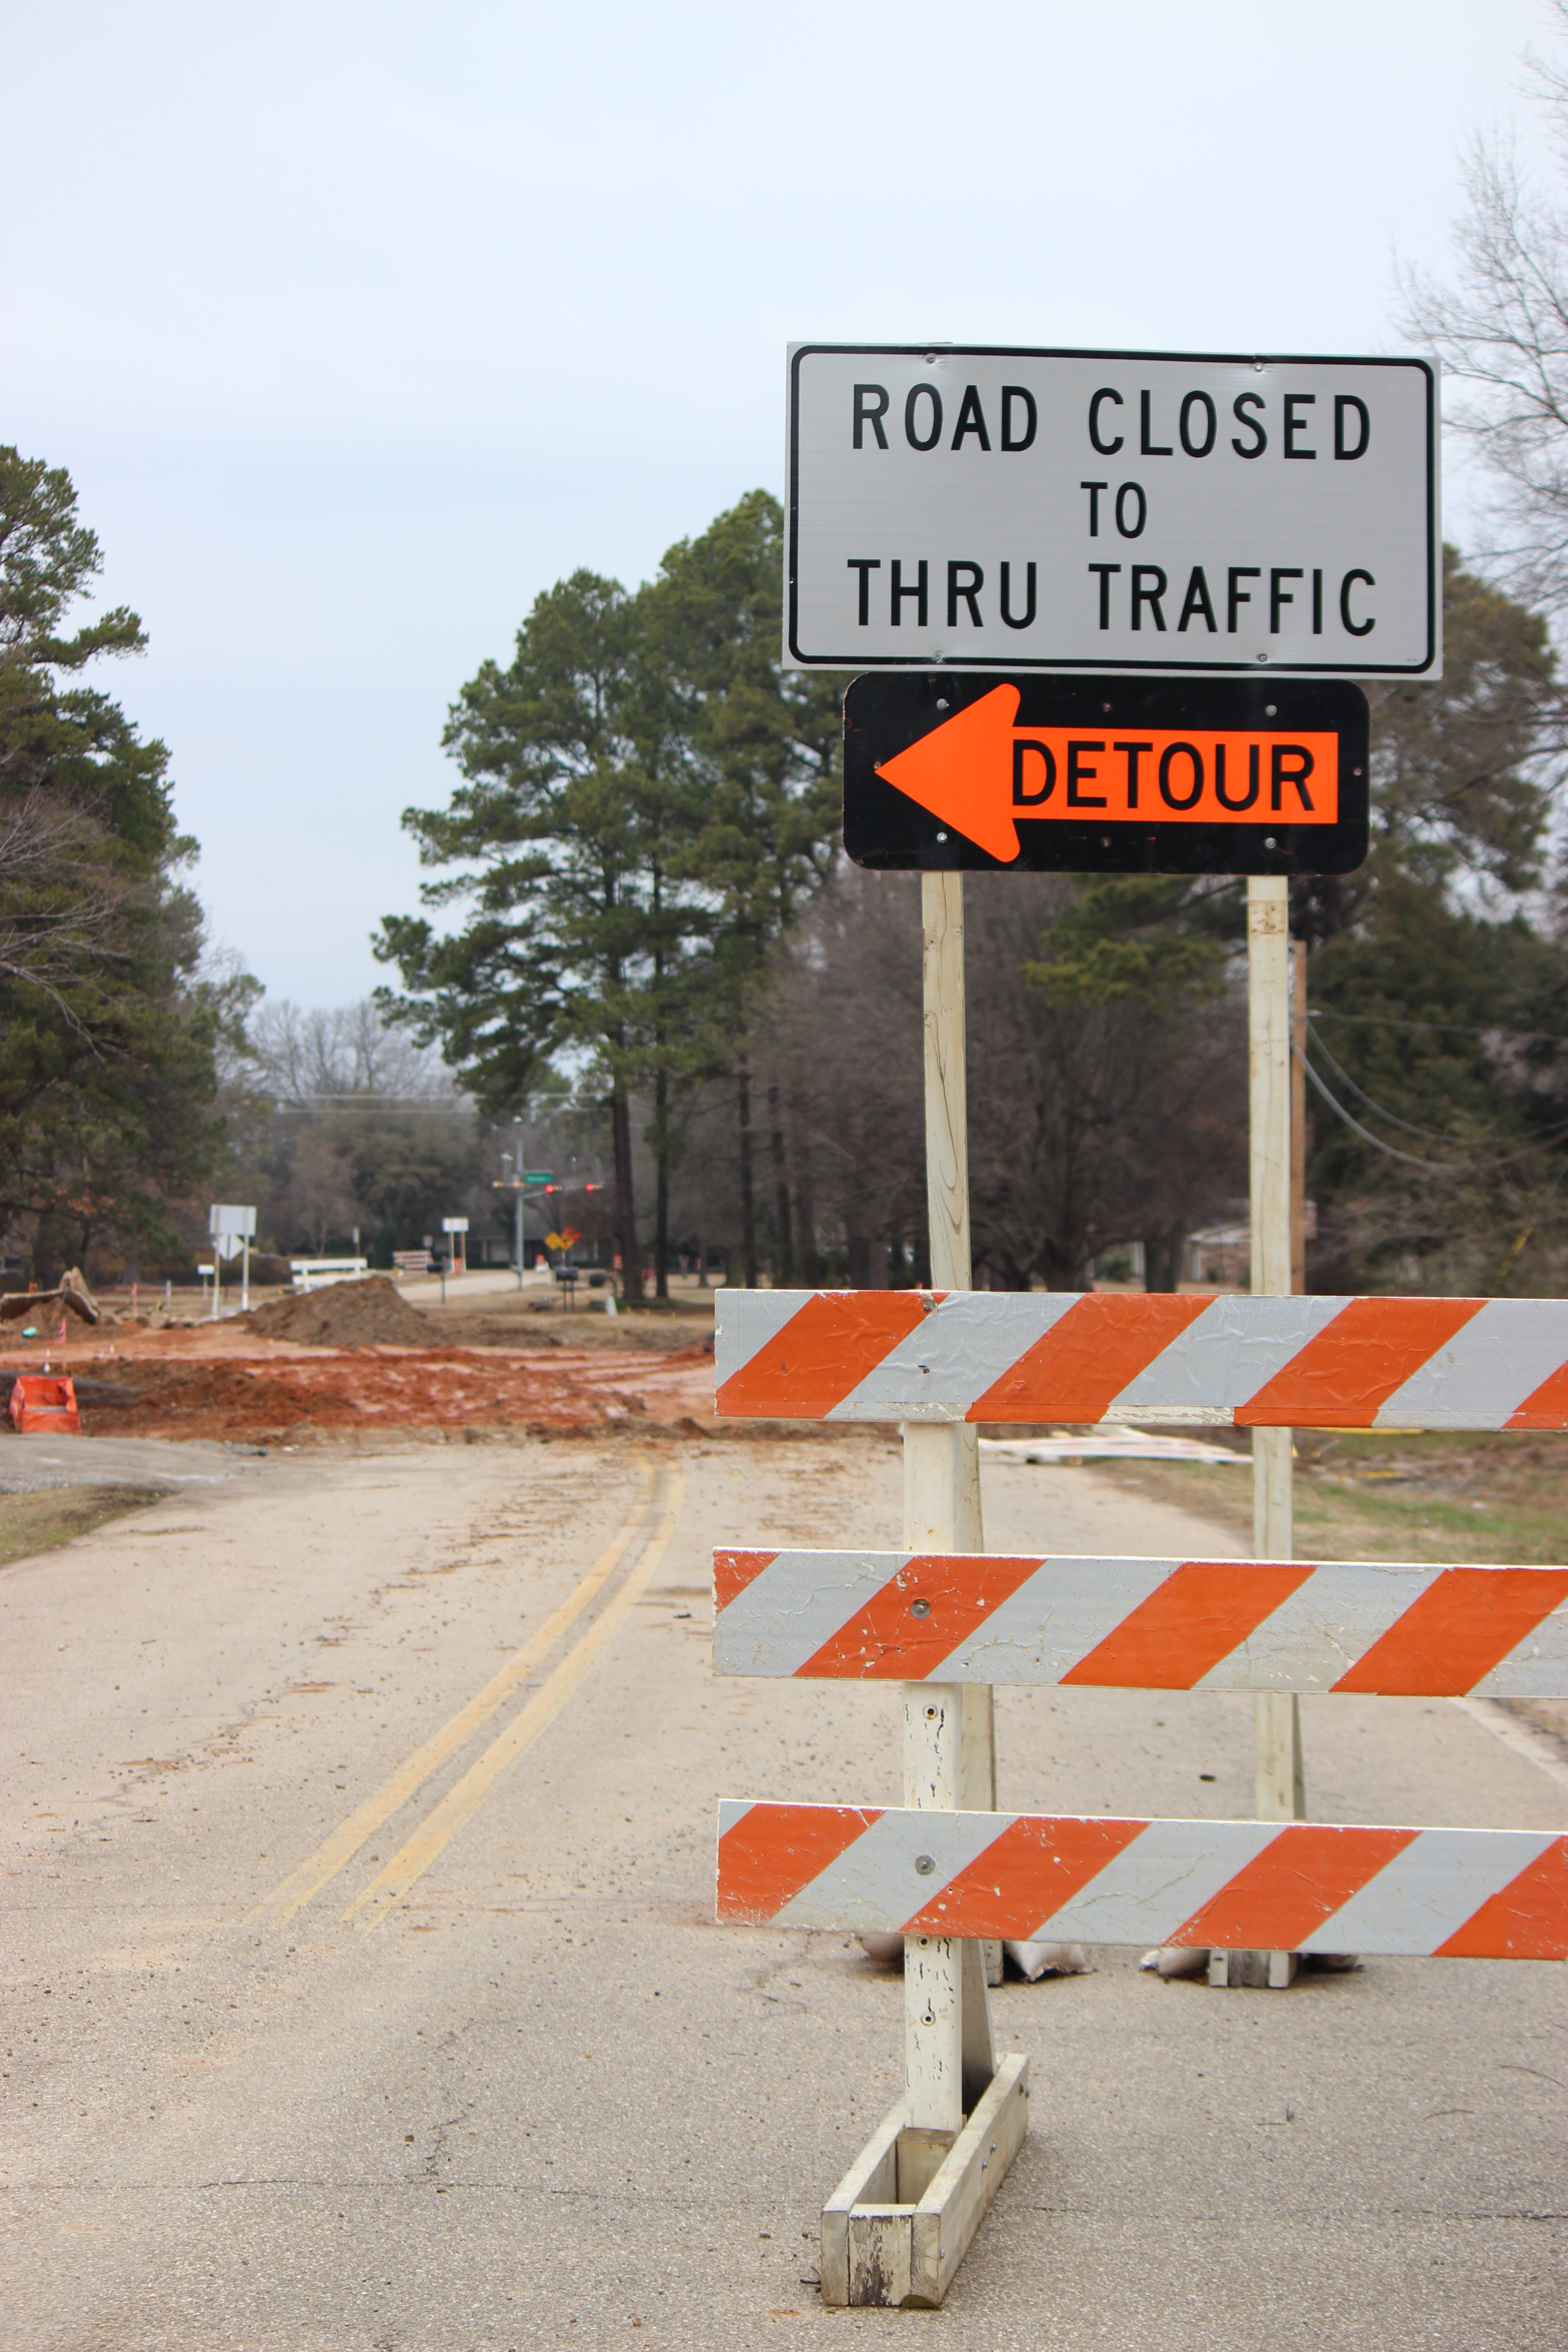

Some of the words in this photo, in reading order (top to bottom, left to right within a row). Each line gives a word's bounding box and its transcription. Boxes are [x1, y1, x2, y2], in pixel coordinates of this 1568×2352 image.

[852, 382, 1039, 453] ROAD
[1088, 387, 1371, 461] CLOSED
[1080, 481, 1148, 539] TO
[847, 559, 1037, 630] THRU
[1088, 563, 1376, 637] TRAFFIC
[1011, 739, 1317, 812] DETOUR
